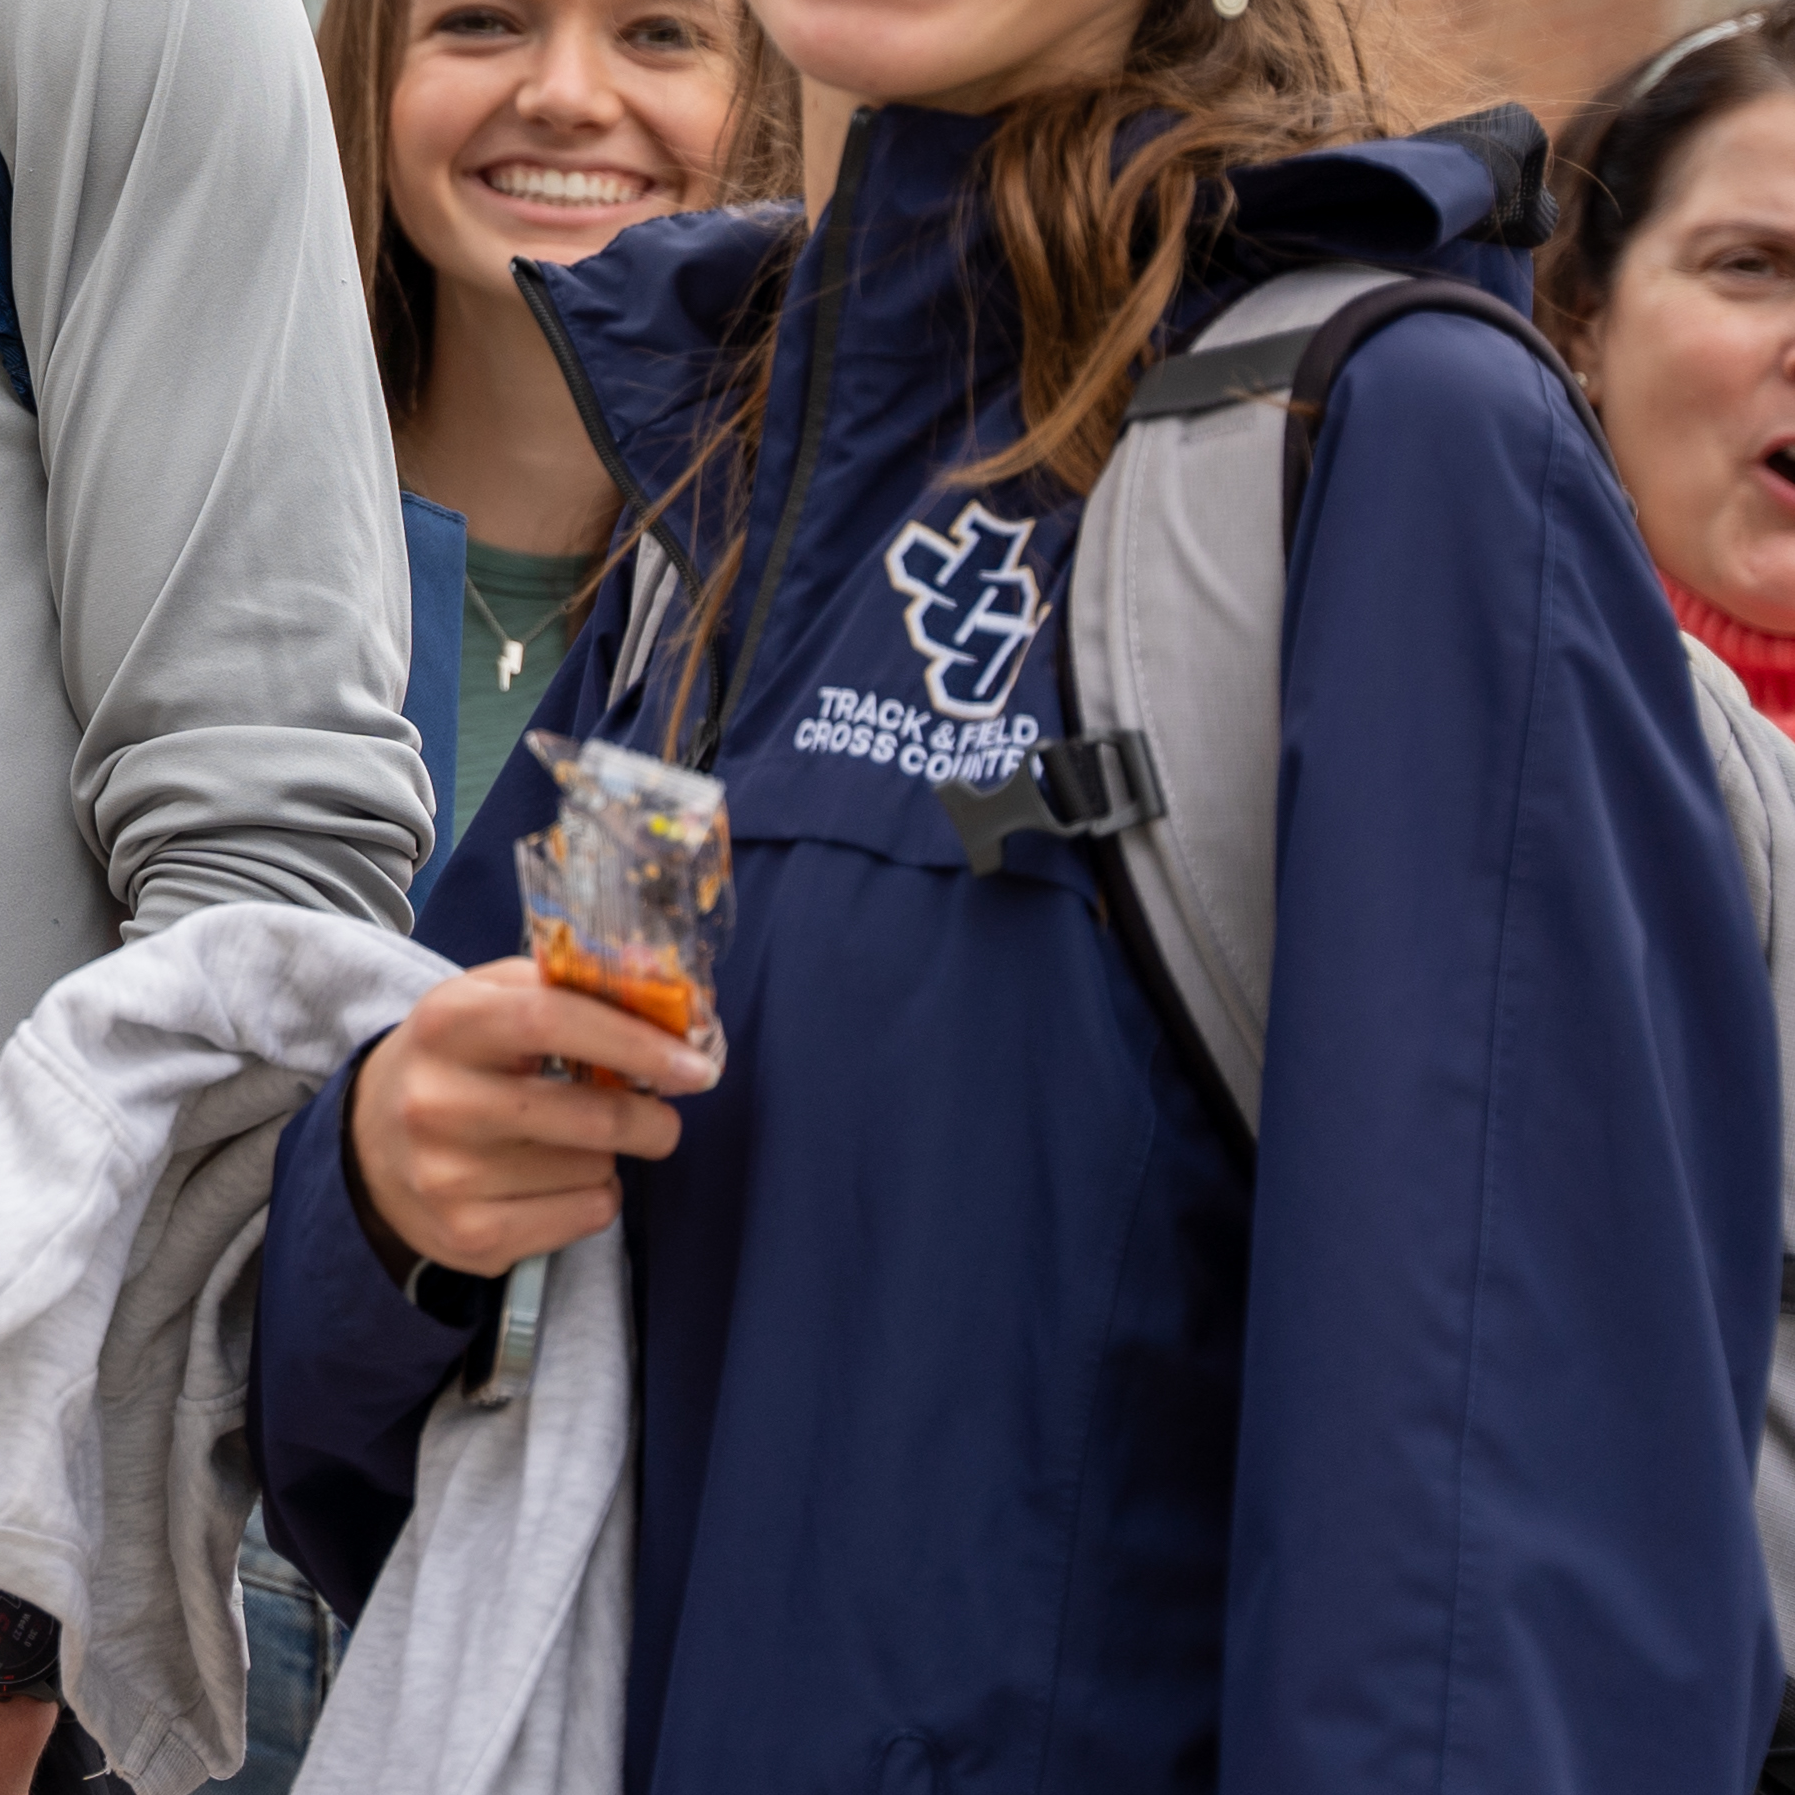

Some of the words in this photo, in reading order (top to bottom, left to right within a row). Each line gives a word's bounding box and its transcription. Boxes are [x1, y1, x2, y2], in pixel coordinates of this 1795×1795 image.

[793, 717, 899, 764] CROSS
[818, 685, 932, 743] TRACK
[929, 719, 957, 753] &
[957, 713, 1040, 755] FIELD
